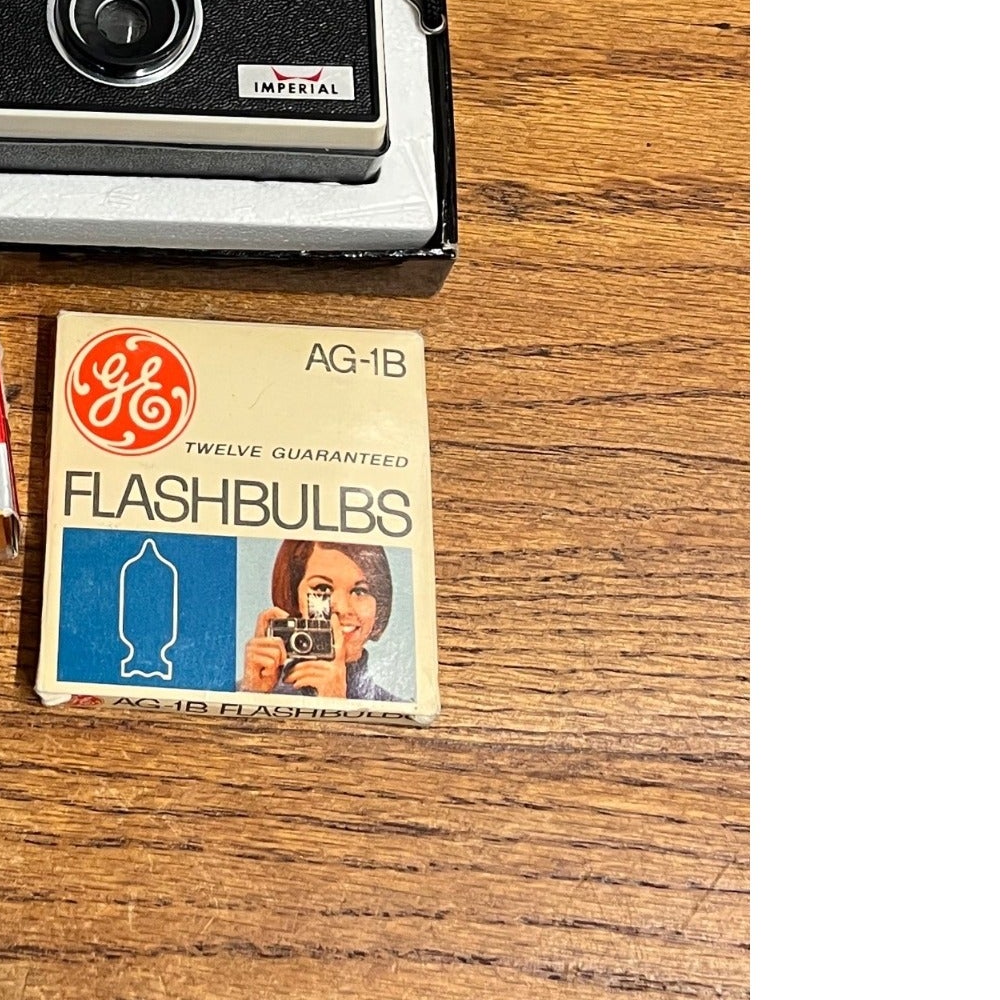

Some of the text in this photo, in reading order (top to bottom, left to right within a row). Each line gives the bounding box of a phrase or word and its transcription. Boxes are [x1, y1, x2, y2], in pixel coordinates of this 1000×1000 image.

[254, 82, 338, 96] IMPERIAL
[305, 343, 407, 379] AG-1B
[185, 441, 409, 468] TWELVE GUARANTEED
[63, 470, 413, 538] FLASHBULBS
[113, 697, 208, 714] AG-1B
